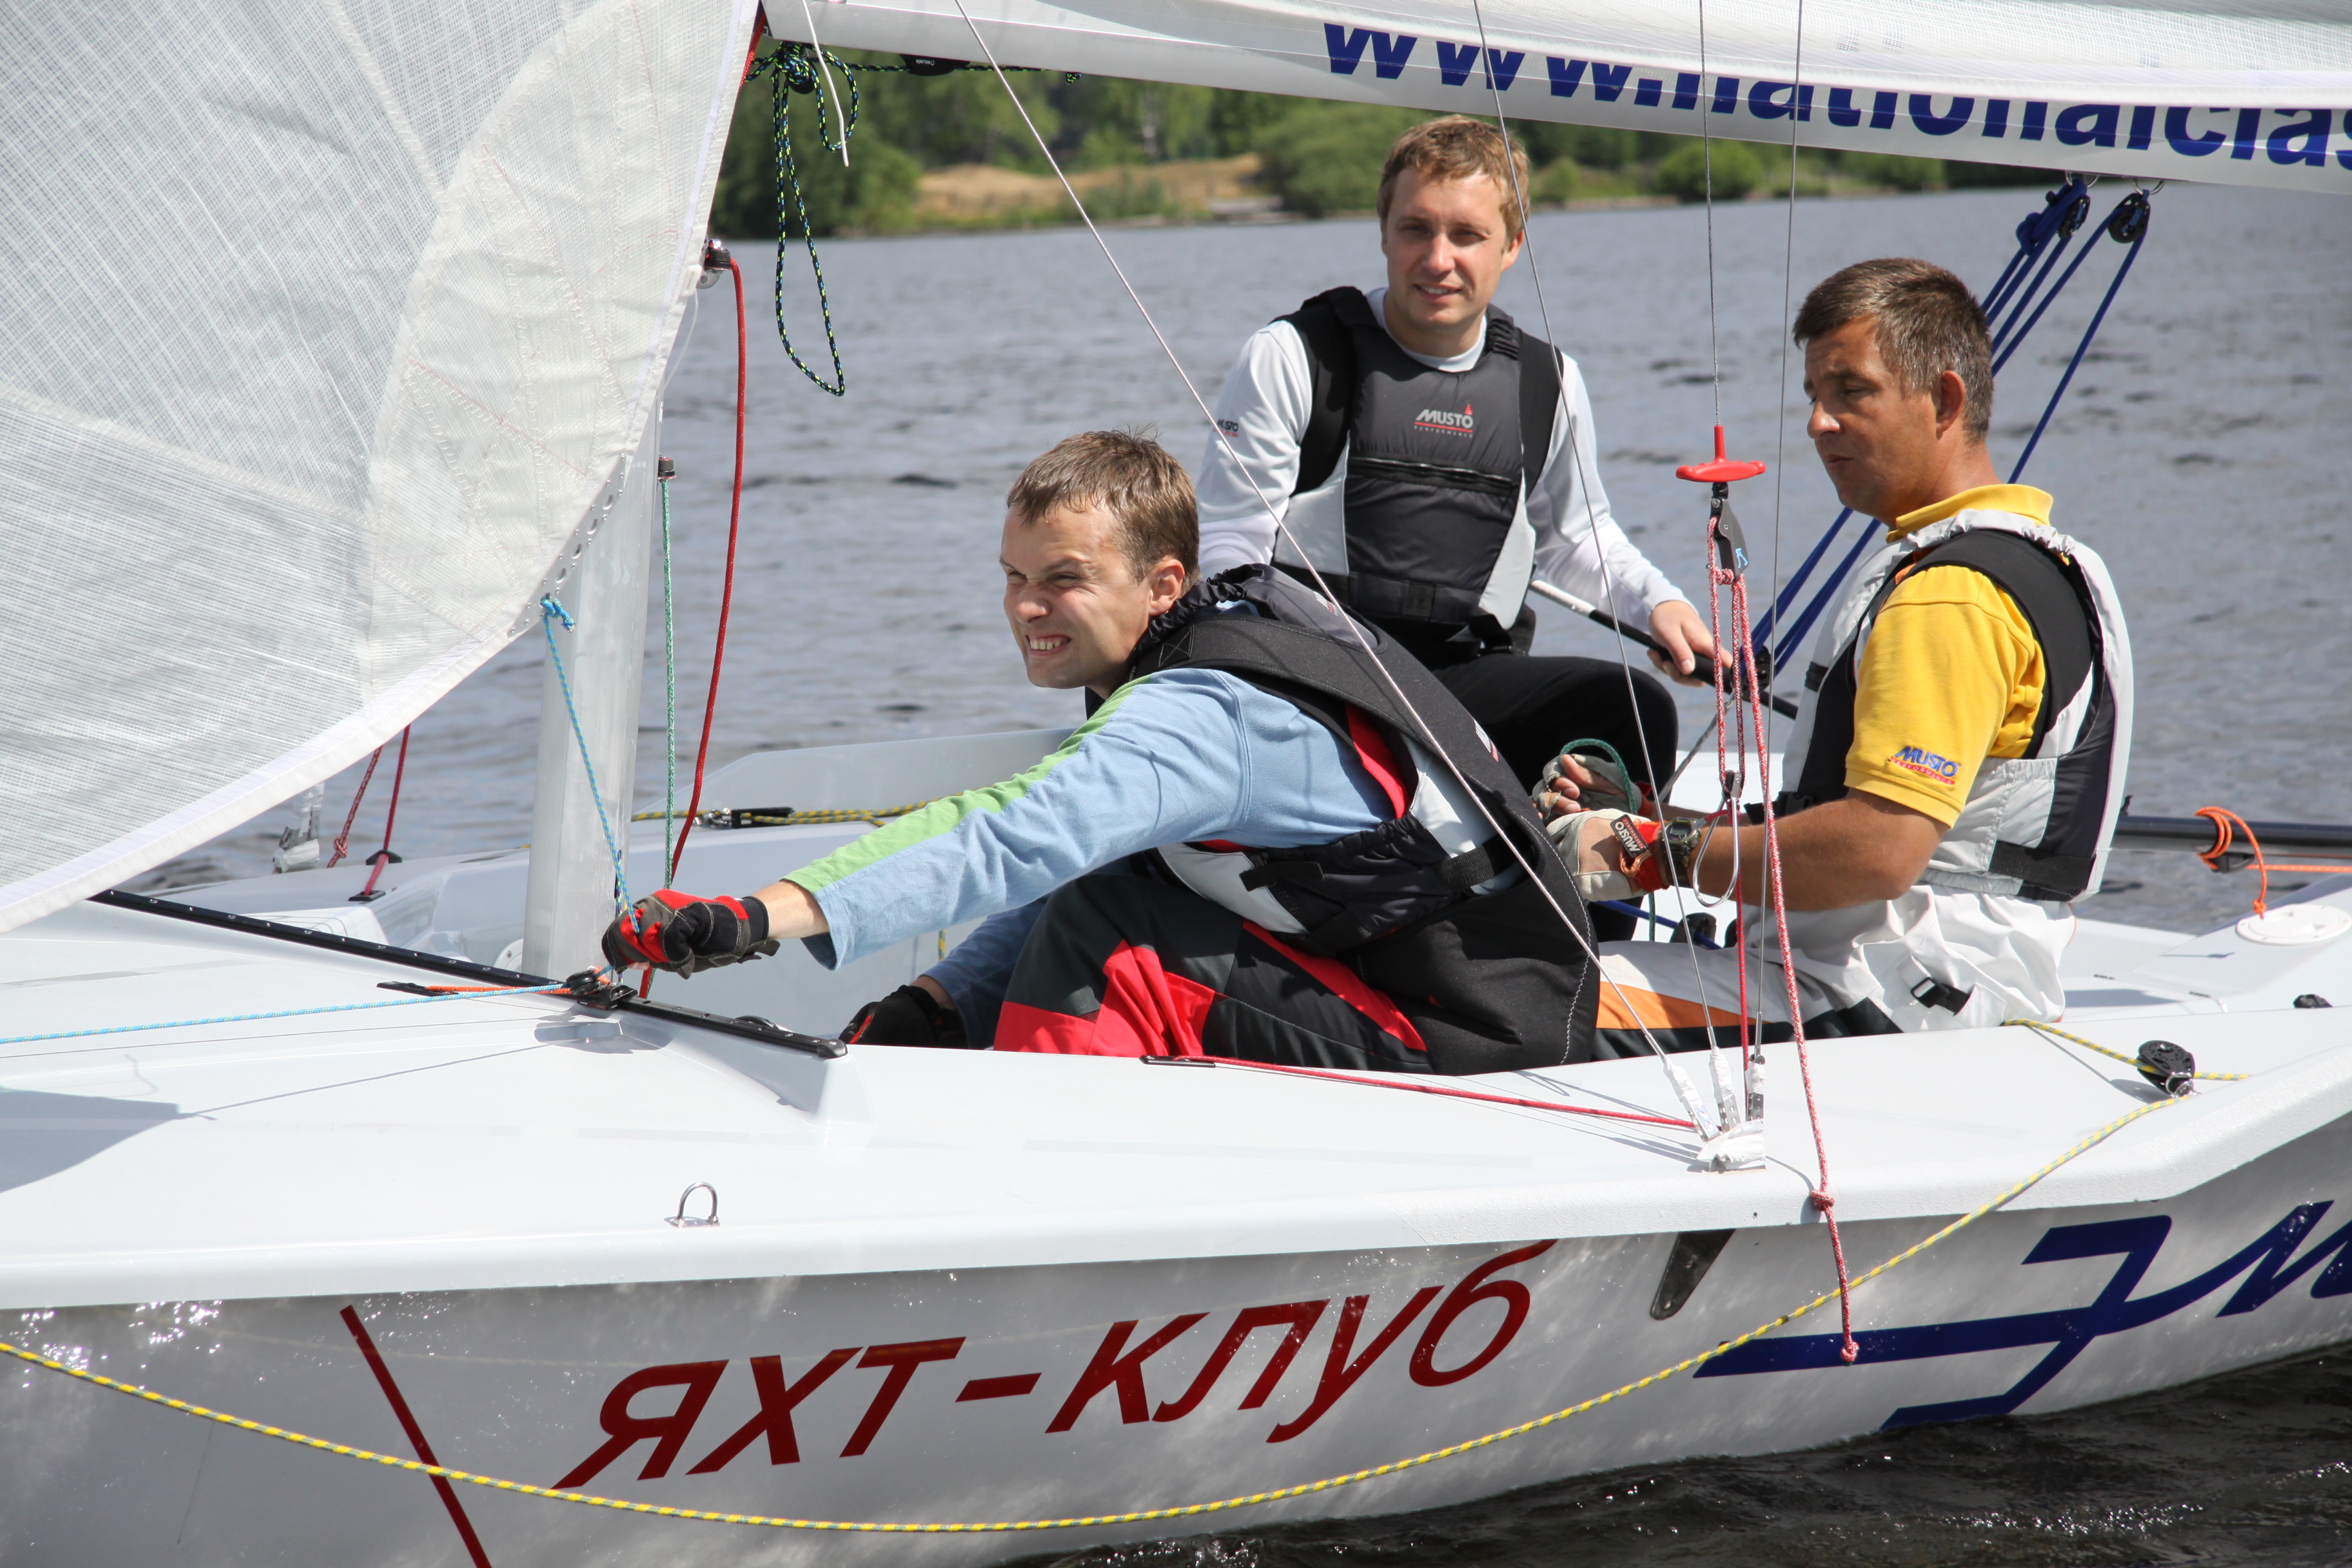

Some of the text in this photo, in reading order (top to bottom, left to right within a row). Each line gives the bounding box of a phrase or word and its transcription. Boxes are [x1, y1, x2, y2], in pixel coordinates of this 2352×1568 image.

[1323, 22, 2352, 171] www.nationalcla
[1414, 425, 1473, 438] PERFORMANCE
[1416, 408, 1473, 429] MUSTO
[1891, 758, 1952, 785] PERFORMANCE
[1894, 746, 1957, 777] MUSTO
[1614, 821, 1640, 851] MUSTO
